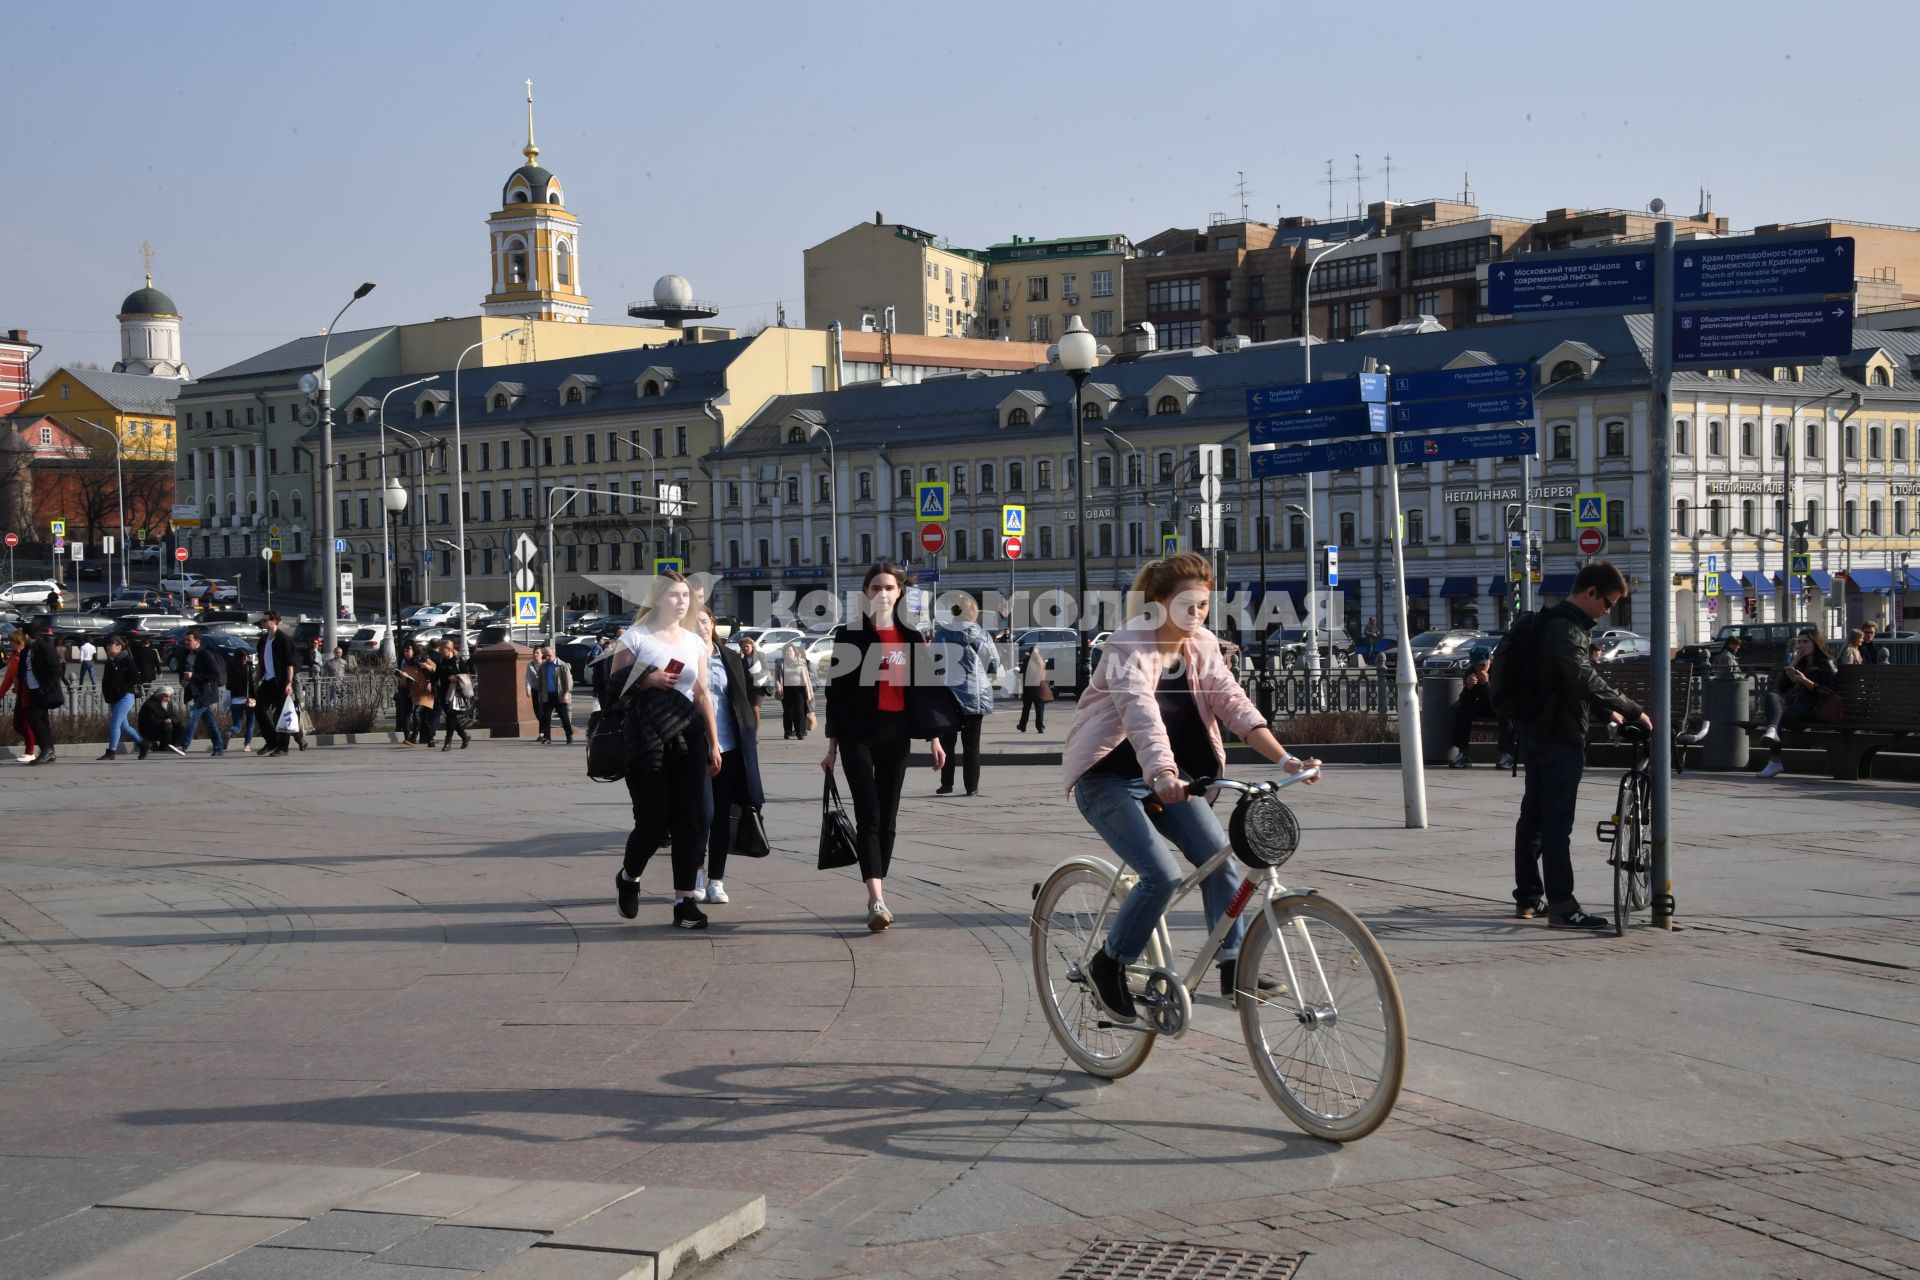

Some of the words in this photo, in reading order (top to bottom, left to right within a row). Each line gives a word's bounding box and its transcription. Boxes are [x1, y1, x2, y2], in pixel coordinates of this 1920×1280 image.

[1702, 255, 1723, 263] Храм
[1725, 250, 1786, 261] преподобного
[1788, 248, 1818, 257] Сергия
[1514, 266, 1563, 276] Московский
[1564, 265, 1587, 273] театр
[1588, 263, 1621, 271] «Школа
[1702, 261, 1760, 271] Радонежского
[1768, 256, 1825, 266] Крапивниках
[1514, 274, 1569, 285] современной
[1701, 271, 1726, 280] Church
[1727, 270, 1735, 278] of
[1771, 267, 1797, 276] Sergius
[1700, 314, 1750, 323] Общественный
[1751, 312, 1769, 320] штаб
[1700, 321, 1743, 330] реализацией
[1744, 319, 1784, 328] Программы
[1785, 317, 1823, 326] реновации
[1721, 332, 1756, 340] committee
[1767, 330, 1806, 338] monitoring
[1750, 337, 1777, 346] program
[1462, 435, 1497, 443] Страстной
[1445, 489, 1517, 502] НЕГЛИННАЯ
[1527, 486, 1573, 498] АЛЕРЕЯ
[1712, 483, 1762, 493] НЕГЛИННАЯ
[1063, 509, 1111, 520] ТООВАЯ
[1190, 503, 1231, 514] ГАЕЯ
[1569, 912, 1585, 923] N
